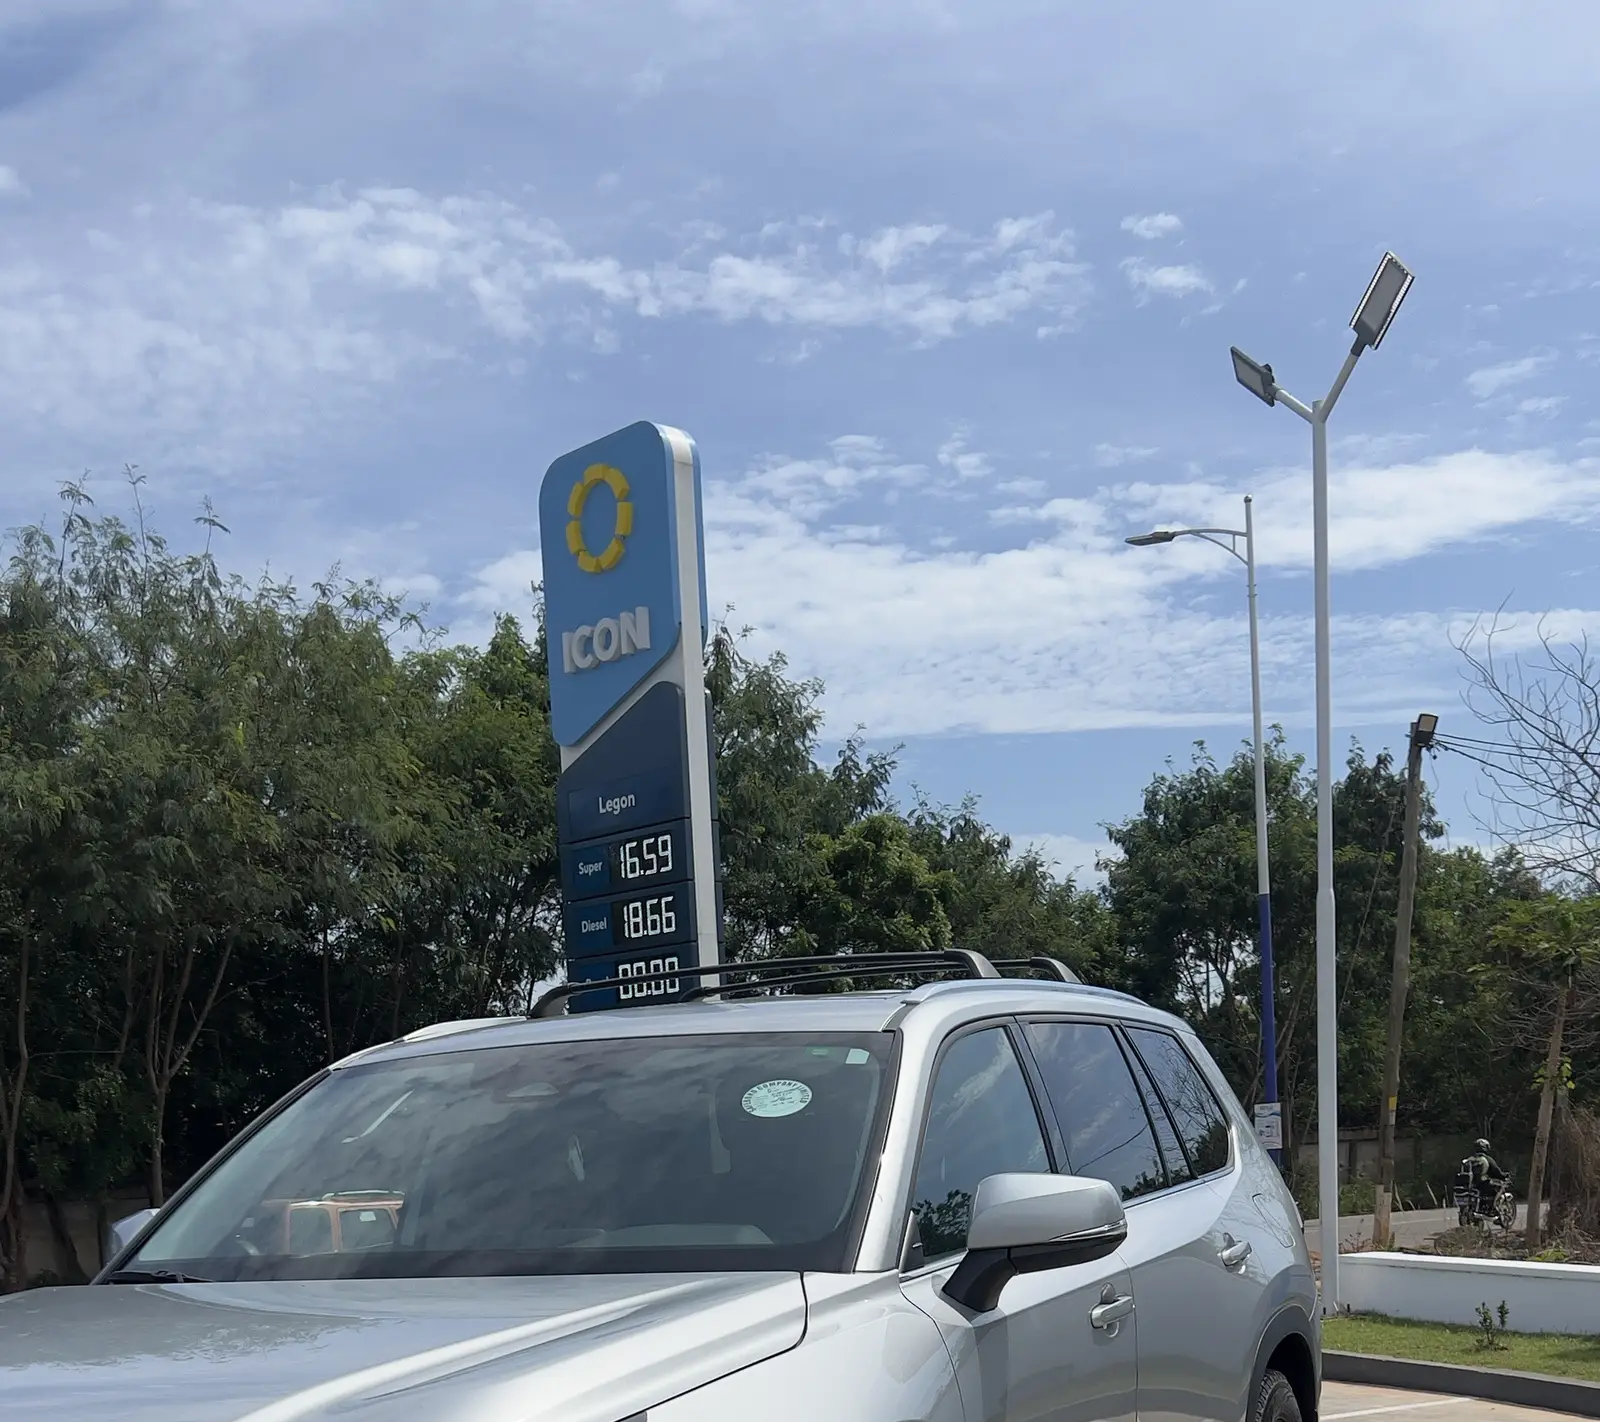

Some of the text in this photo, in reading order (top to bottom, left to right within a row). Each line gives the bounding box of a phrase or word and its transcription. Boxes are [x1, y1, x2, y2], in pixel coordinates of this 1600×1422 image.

[562, 606, 650, 674] ICON
[598, 793, 636, 815] Legon
[578, 834, 673, 879] Super 16.59
[581, 896, 676, 939] Diesel 18.66
